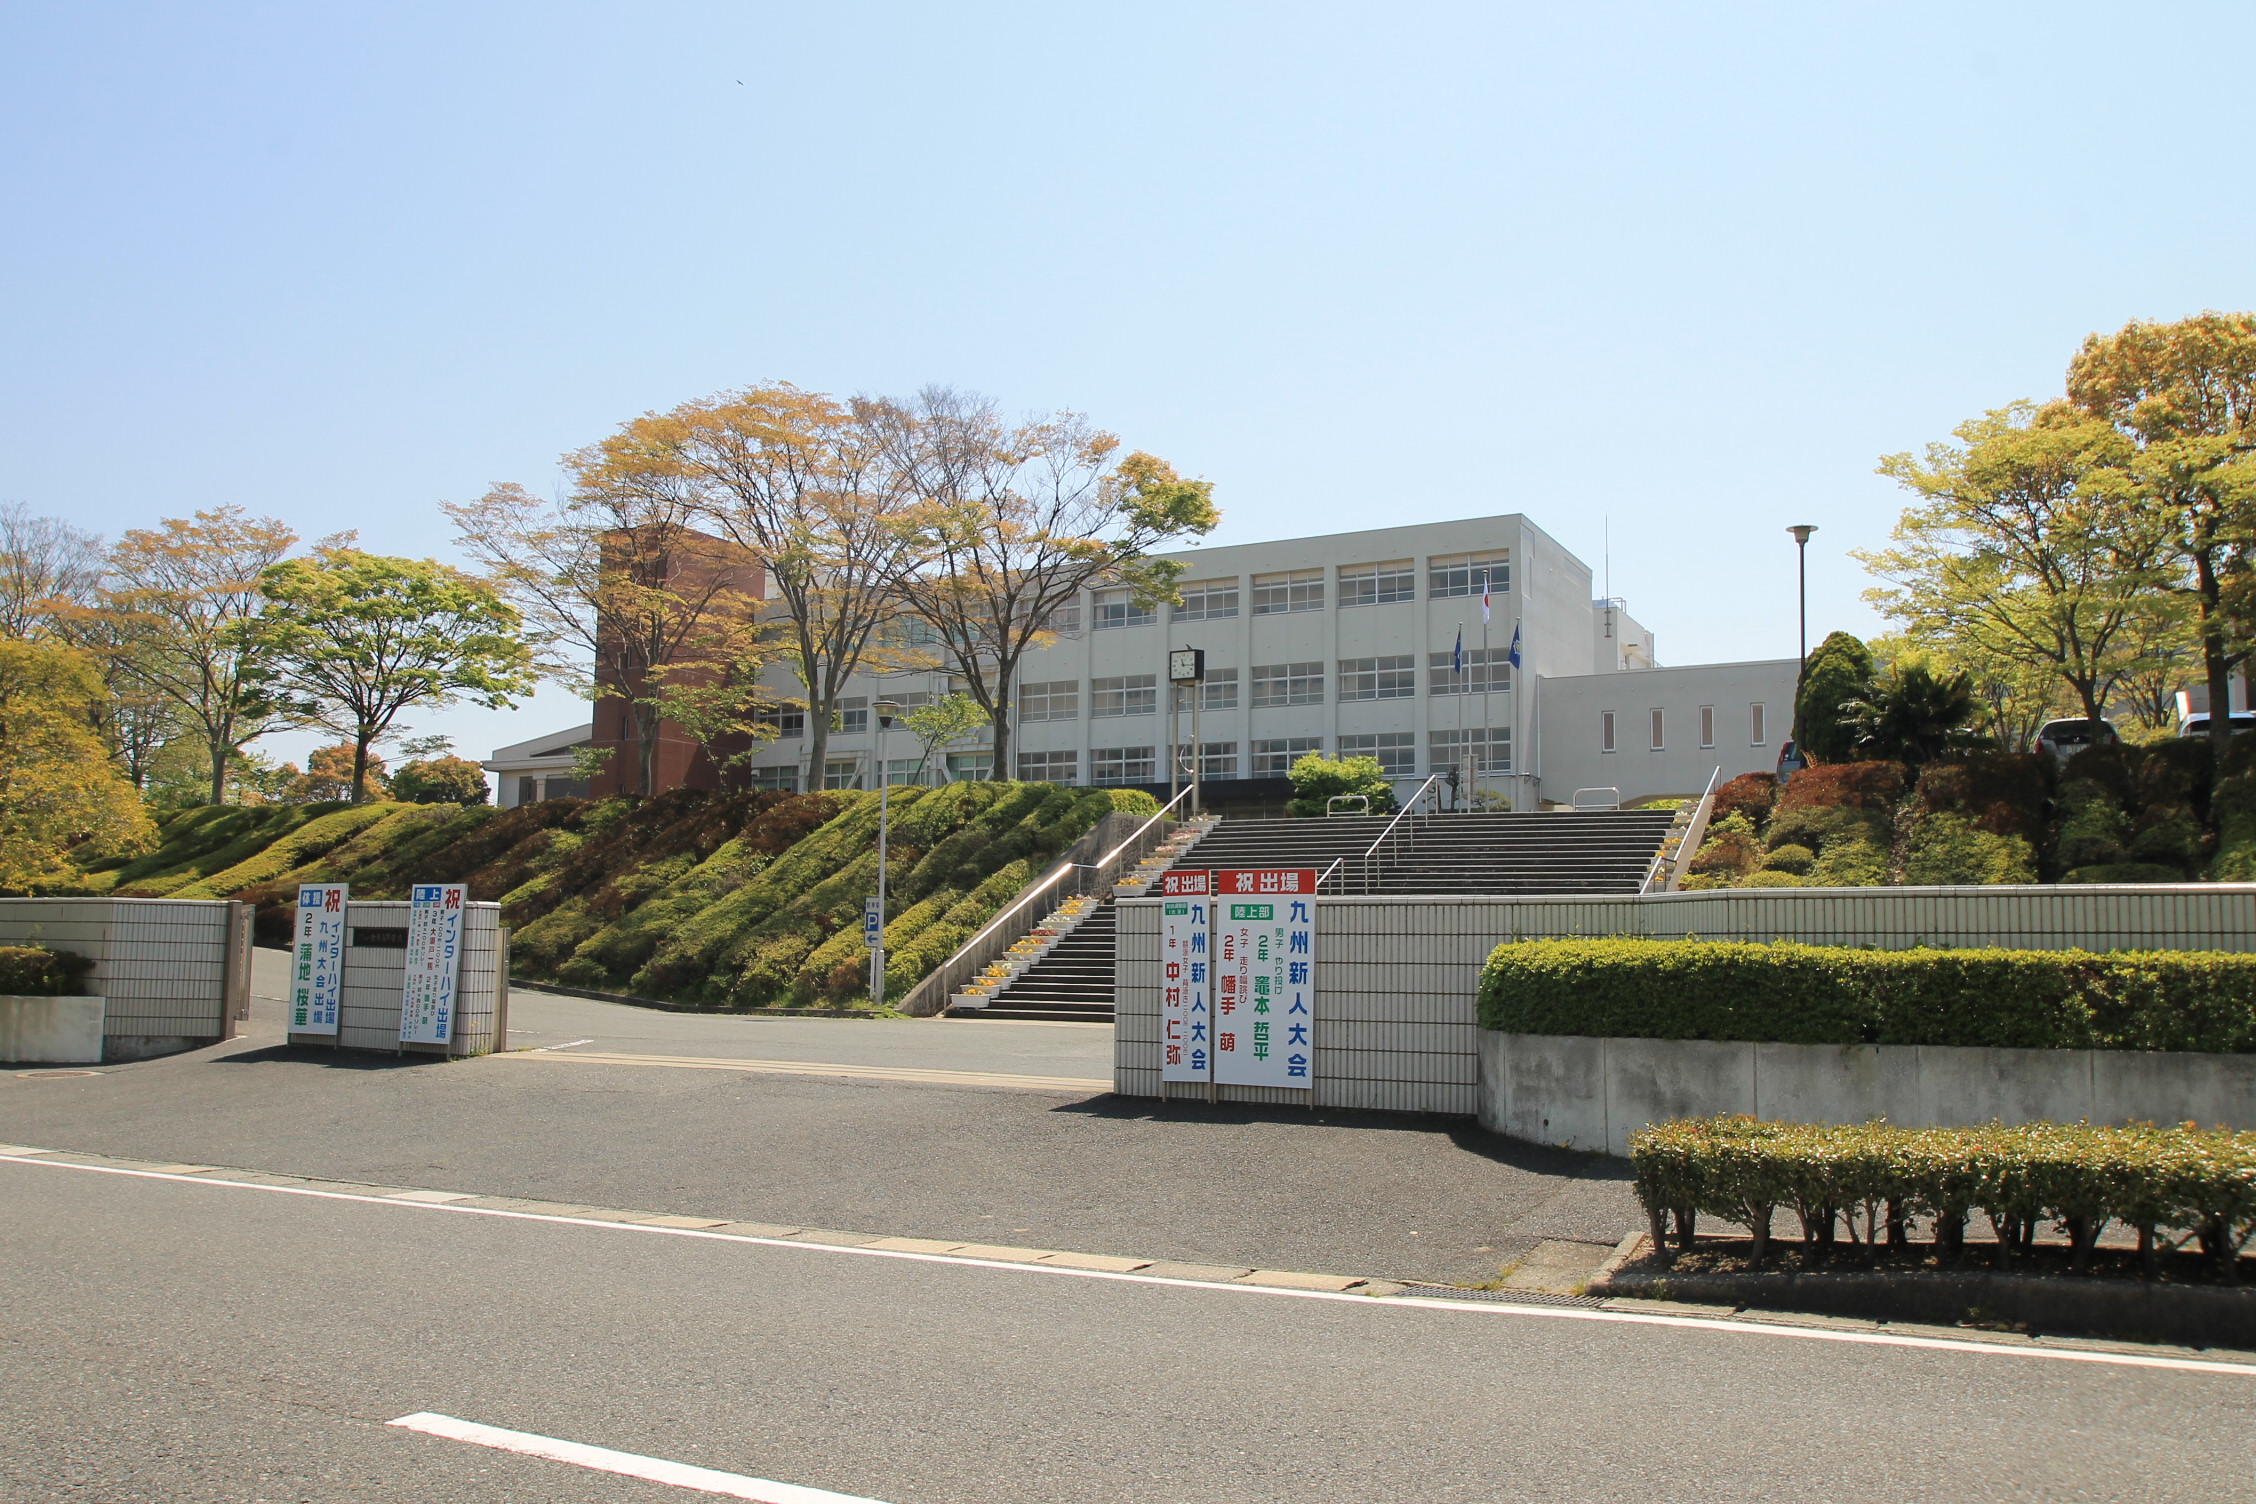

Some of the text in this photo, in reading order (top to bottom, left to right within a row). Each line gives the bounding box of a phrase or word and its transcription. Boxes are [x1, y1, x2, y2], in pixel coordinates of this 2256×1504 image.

[415, 888, 440, 901] 陸上
[1165, 875, 1206, 893] 祝 出場
[1236, 872, 1299, 892] 祝 出場
[325, 889, 341, 913] 祝
[445, 889, 461, 910] 祝
[1234, 906, 1270, 918] 陸上部
[431, 910, 438, 925] 3年
[867, 914, 878, 930] P
[1168, 925, 1177, 949] 1年
[1223, 934, 1234, 962] 2年
[1257, 935, 1269, 962] 2年
[294, 912, 313, 1026] 2年 蒲地 桜華
[313, 921, 328, 1024] 九州大会出場
[324, 921, 341, 1025] インターハイ出場
[1239, 927, 1249, 1004] 女子 走り幅跳び
[1274, 927, 1284, 995] 男子 やり投げ
[435, 913, 458, 1039] インターハイ出場
[1166, 961, 1180, 1008] 中村
[1191, 904, 1206, 1071] 九州新人大会
[1287, 900, 1309, 1078] 九州新人大会
[1166, 1018, 1181, 1066] 仁弥
[1220, 1032, 1236, 1052] 萌
[1253, 1021, 1269, 1062] 哲平
